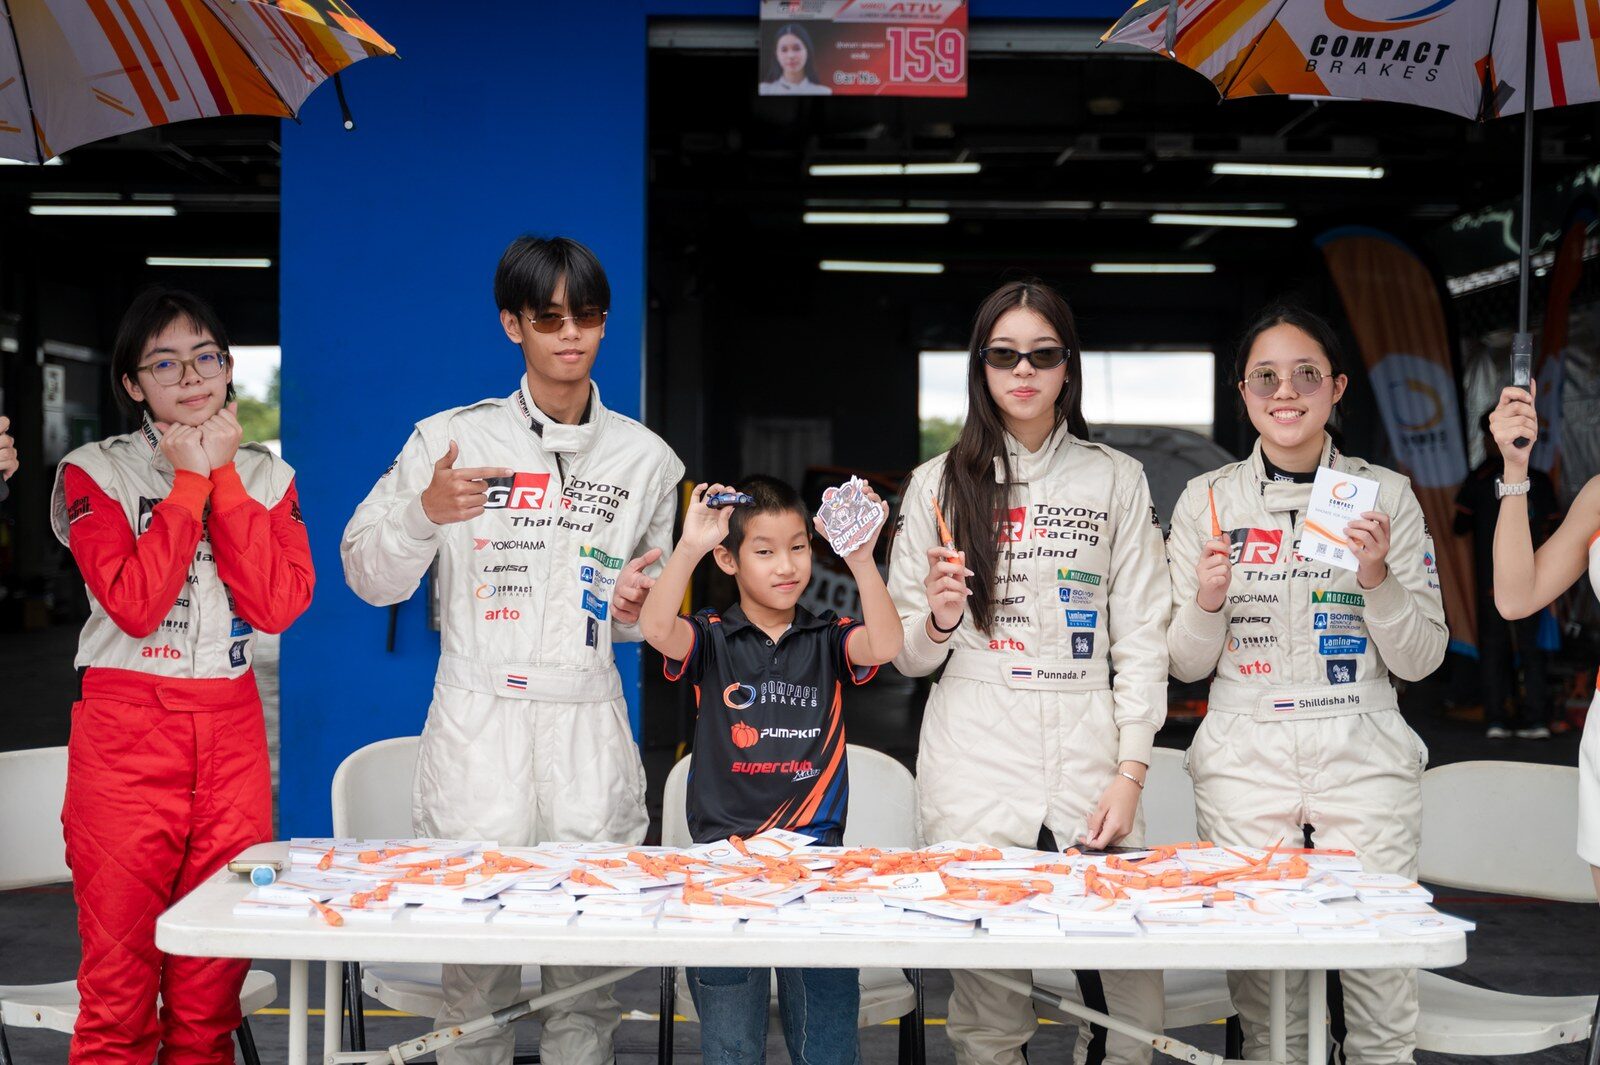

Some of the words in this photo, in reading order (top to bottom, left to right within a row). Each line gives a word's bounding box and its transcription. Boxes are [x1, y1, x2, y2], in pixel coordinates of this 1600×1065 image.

[889, 3, 942, 13] ATIV
[886, 27, 964, 82] 159
[1310, 34, 1450, 66] COMPACT
[1305, 59, 1438, 82] BRAKES
[570, 475, 630, 500] TOYOTA
[484, 486, 545, 509] GR
[560, 497, 615, 523] Racing
[1034, 504, 1108, 521] TOYOTA
[511, 516, 594, 533] Thailand
[1034, 516, 1099, 532] GAZOO
[833, 523, 861, 549] SUPER
[1034, 528, 1099, 546] Racing
[491, 540, 547, 551] YOKOHAMA
[483, 564, 529, 573] LENSO
[1243, 568, 1331, 581] Thailand
[994, 574, 1029, 584] OHAMA
[498, 585, 533, 593] COMPACT
[996, 596, 1026, 606] NSO
[1228, 594, 1279, 604] YOKOHAMA
[1326, 592, 1366, 606] MODELLIST
[484, 607, 520, 620] arto
[1230, 616, 1272, 624] ENSO
[989, 638, 1025, 652] arto
[1242, 635, 1279, 645] COMPACT
[1323, 637, 1351, 647] Lamina
[141, 644, 182, 660] arto
[1240, 660, 1272, 675] arto
[1037, 670, 1079, 680] Punnada.
[1081, 670, 1087, 680] P
[761, 681, 818, 700] COMPACT
[760, 694, 818, 708] BRAKES
[1299, 697, 1345, 709] Shilldisha
[1347, 694, 1360, 705] Ng
[760, 728, 821, 739] PUMPKIN
[731, 760, 812, 775] superclub
